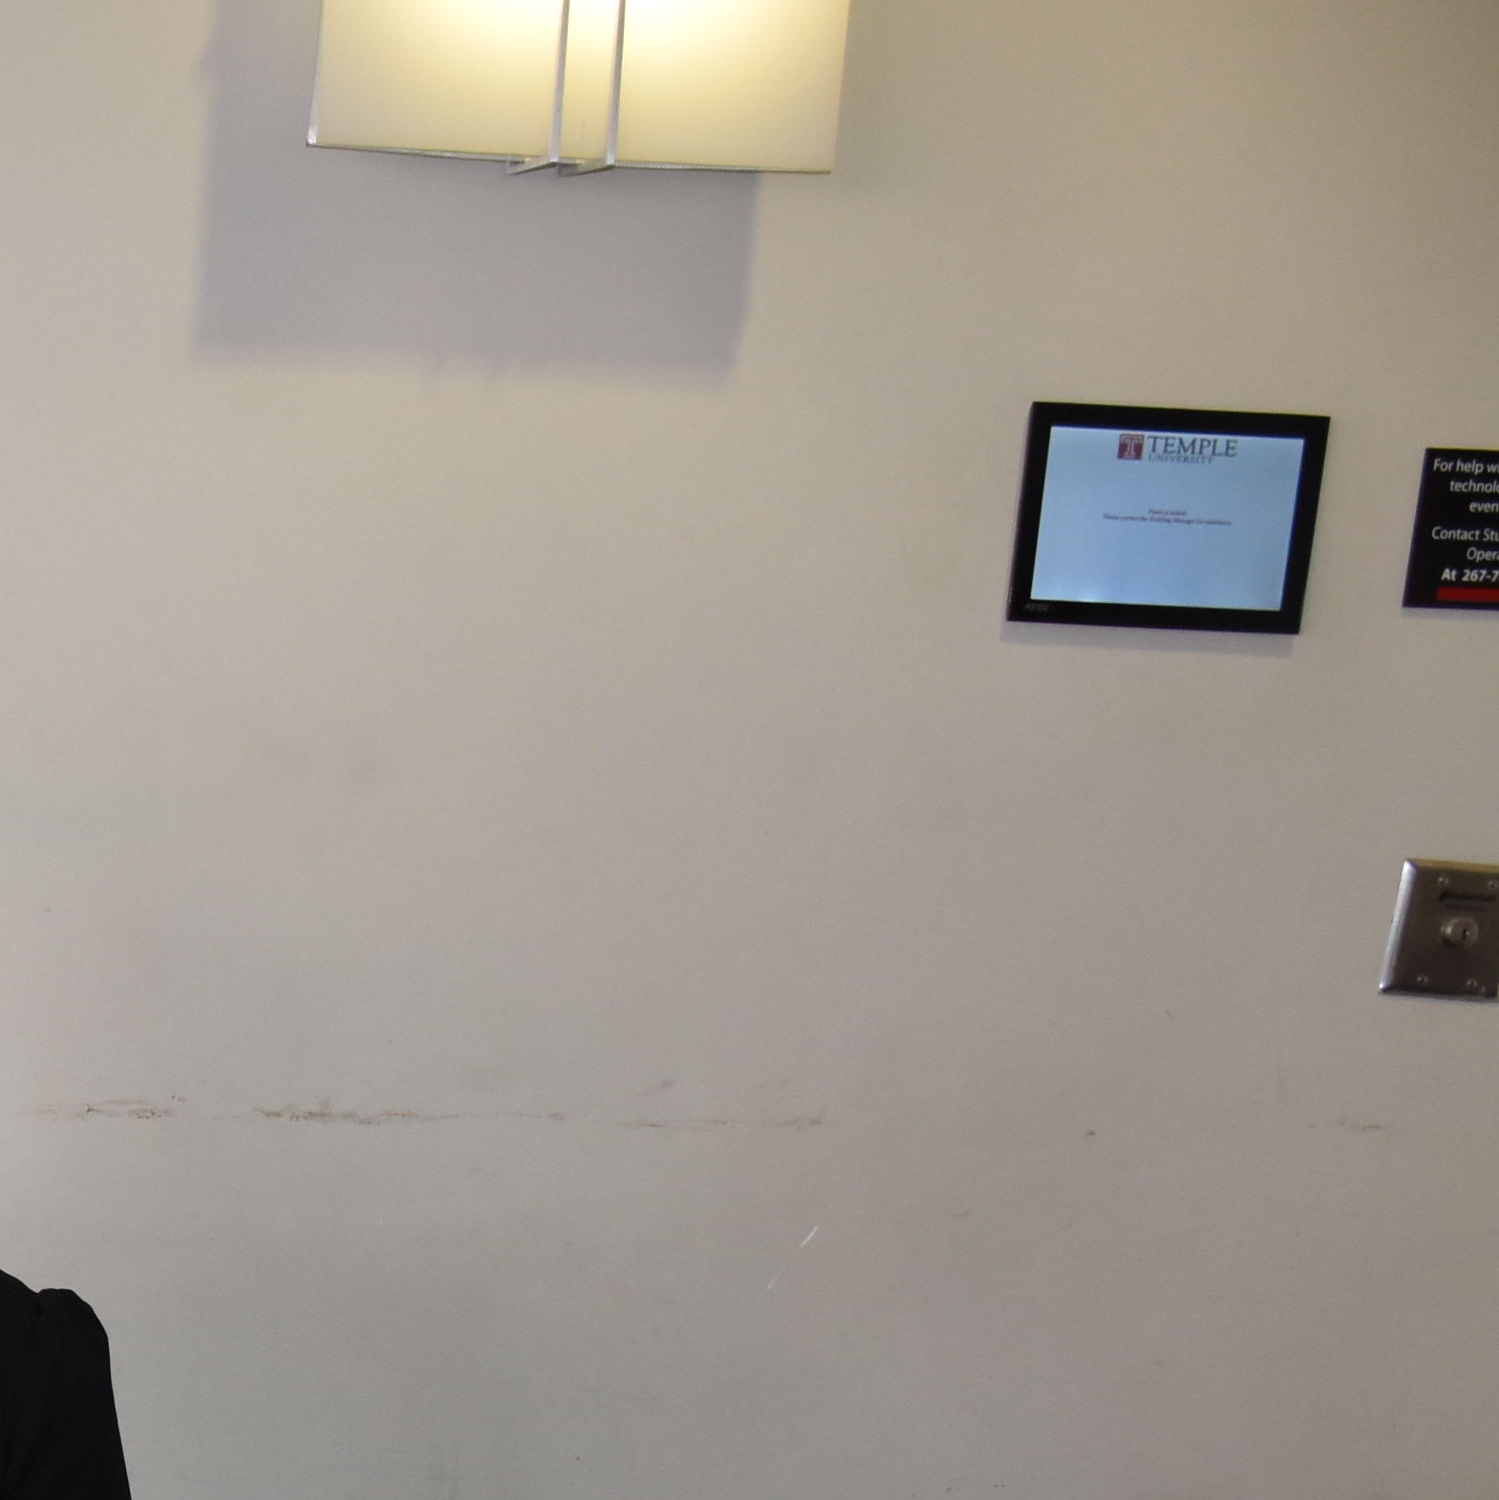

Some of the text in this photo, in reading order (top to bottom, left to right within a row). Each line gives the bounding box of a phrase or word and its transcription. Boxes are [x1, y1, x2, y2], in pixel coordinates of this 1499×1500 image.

[1147, 436, 1238, 457] TEMPLE
[1433, 458, 1453, 472] For
[1456, 459, 1483, 475] help
[1431, 526, 1480, 541] Contact
[1441, 568, 1456, 581] At
